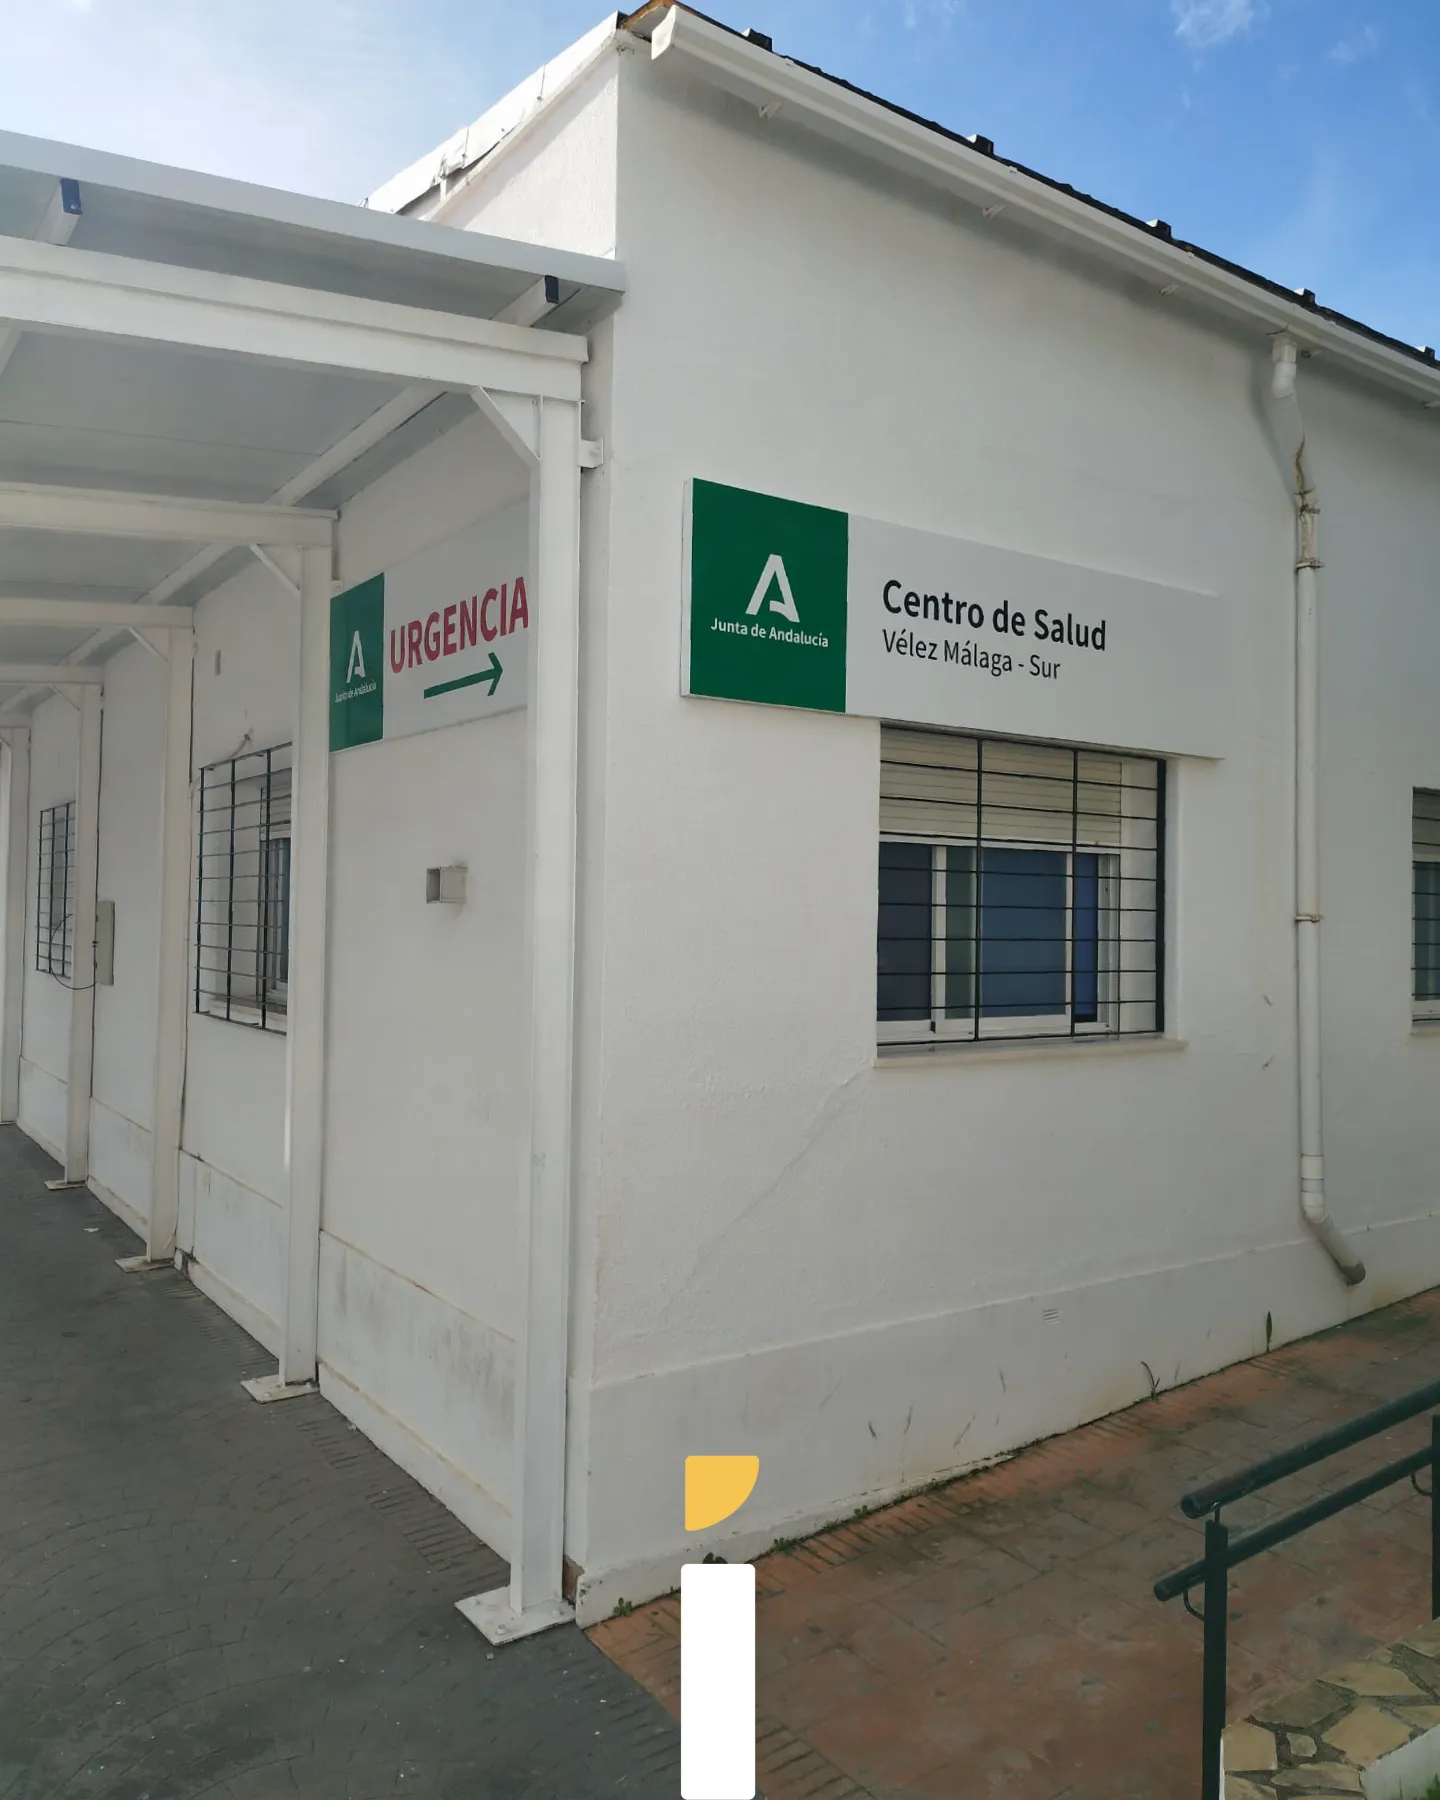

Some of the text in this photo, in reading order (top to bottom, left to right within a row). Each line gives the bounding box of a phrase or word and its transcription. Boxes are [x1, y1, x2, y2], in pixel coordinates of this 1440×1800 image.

[390, 576, 529, 674] URGENCIA
[711, 617, 829, 648] Junta de Andalucía
[883, 579, 1106, 651] Centro de Salud
[882, 628, 938, 661] Vélez
[944, 640, 1012, 677] Málaga
[1029, 654, 1061, 679] Sur
